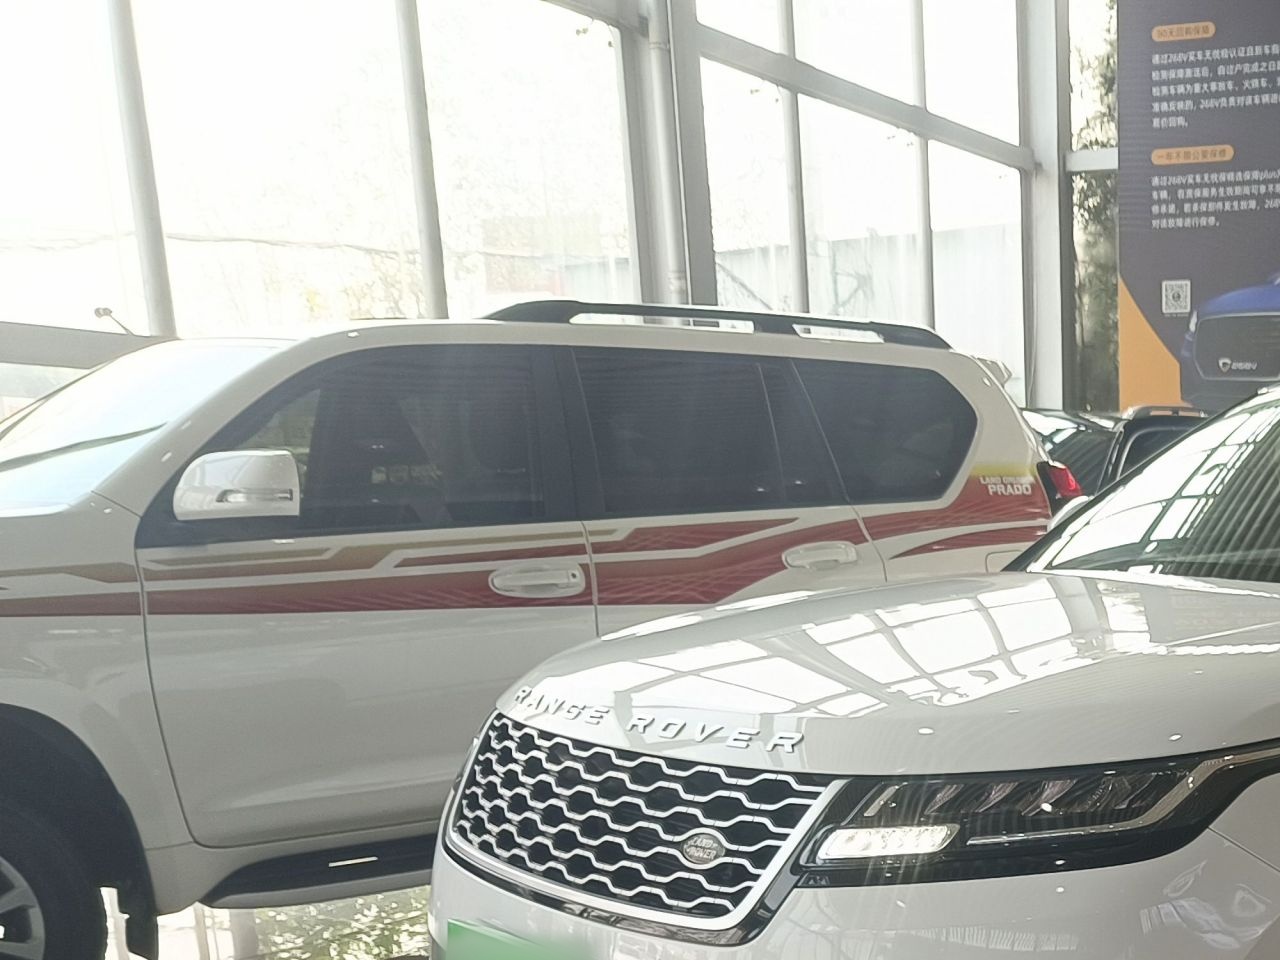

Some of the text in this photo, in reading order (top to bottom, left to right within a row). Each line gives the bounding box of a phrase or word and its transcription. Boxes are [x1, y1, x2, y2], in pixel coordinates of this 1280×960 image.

[987, 484, 1032, 496] PRADO
[513, 685, 804, 753] RANGE ROVER
[688, 845, 717, 860] ROVER
